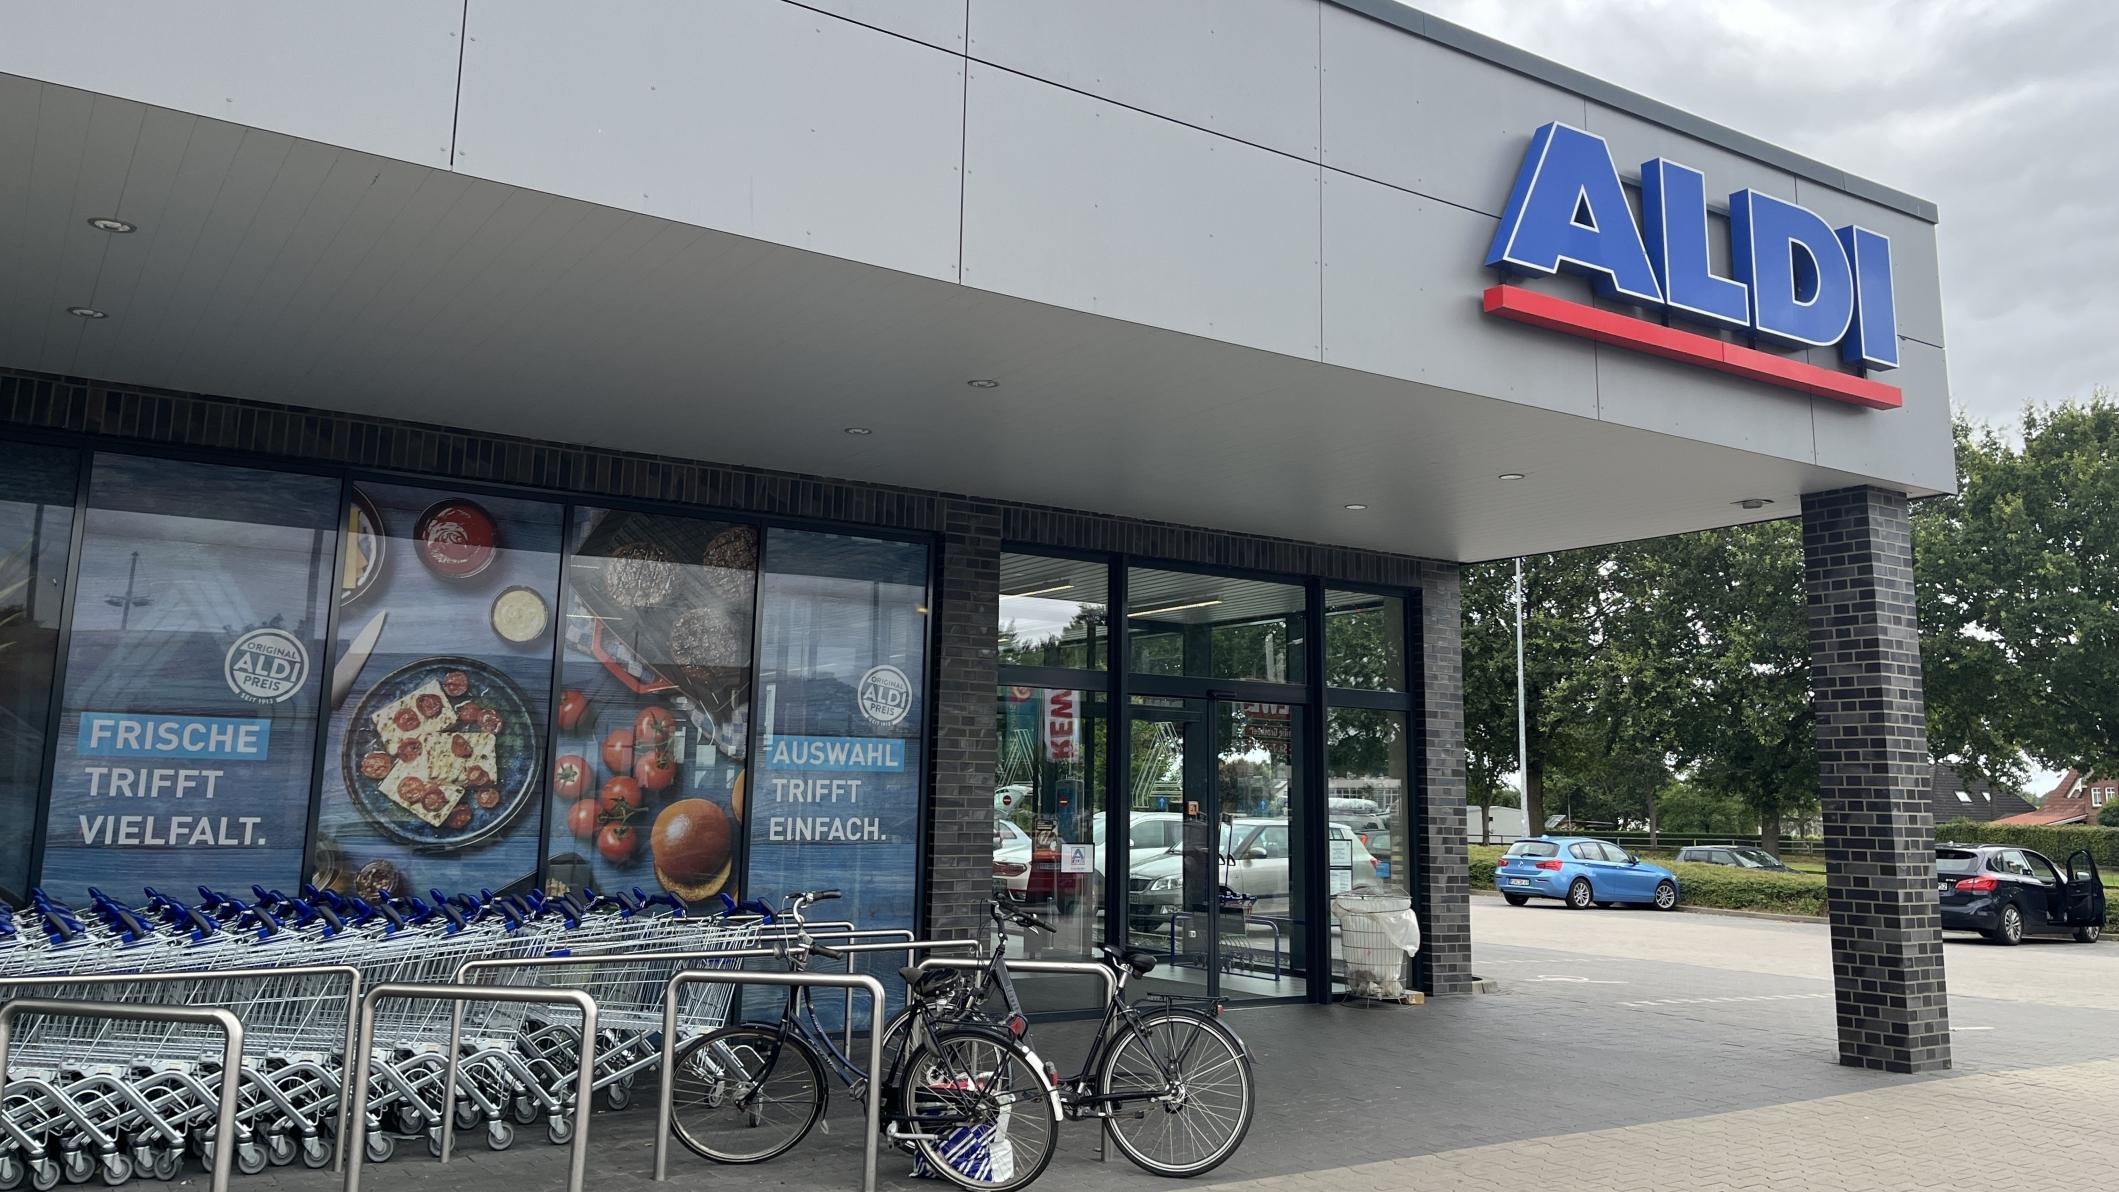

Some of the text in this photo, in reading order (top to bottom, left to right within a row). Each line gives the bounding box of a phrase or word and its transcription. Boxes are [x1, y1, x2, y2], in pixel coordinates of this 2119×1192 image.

[1485, 120, 1899, 372] ALDI
[247, 641, 297, 660] ORIGINAL
[233, 652, 301, 682] ALDI
[243, 675, 281, 692] PREIS
[871, 676, 904, 690] ORIGINAL
[240, 692, 256, 704] SEIT
[863, 684, 907, 709] ALDI
[870, 703, 895, 716] PREIS
[90, 719, 259, 754] FRISCHE
[772, 741, 899, 767] AUSWAHL
[85, 766, 224, 799] TRIFFT
[772, 778, 861, 803] TRIFFT
[79, 815, 266, 846] VIELFALT.
[769, 816, 887, 841] EINFACH.
